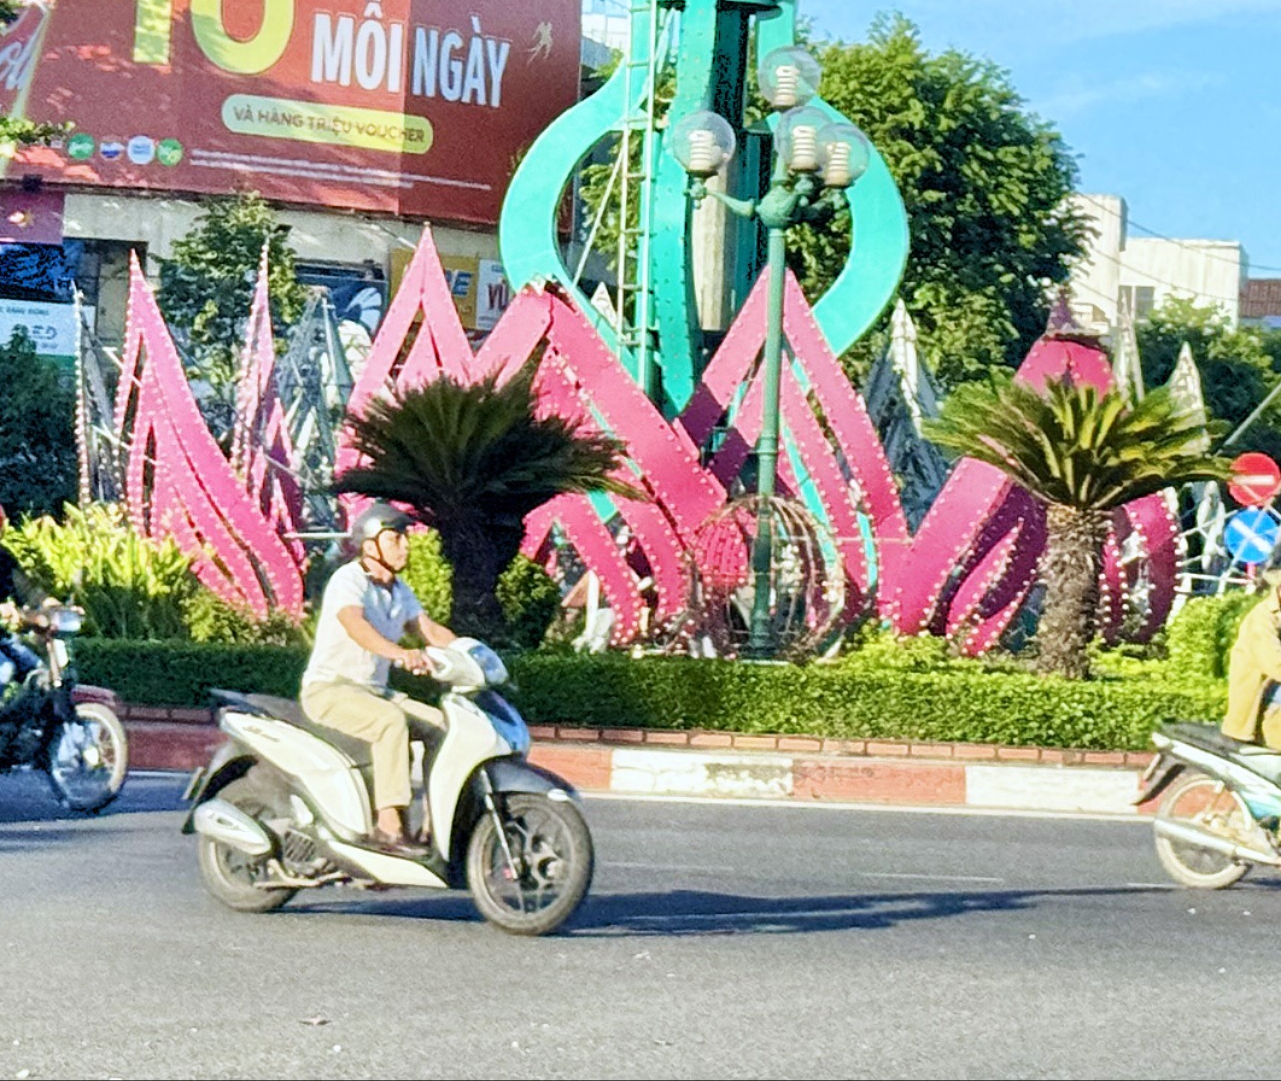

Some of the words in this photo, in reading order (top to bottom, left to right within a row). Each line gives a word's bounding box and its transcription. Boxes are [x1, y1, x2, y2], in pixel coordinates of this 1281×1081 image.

[412, 15, 511, 109] NGÀY
[232, 103, 254, 121] VÀ
[257, 107, 304, 128] HÀNG
[355, 122, 426, 144] VOUCHER
